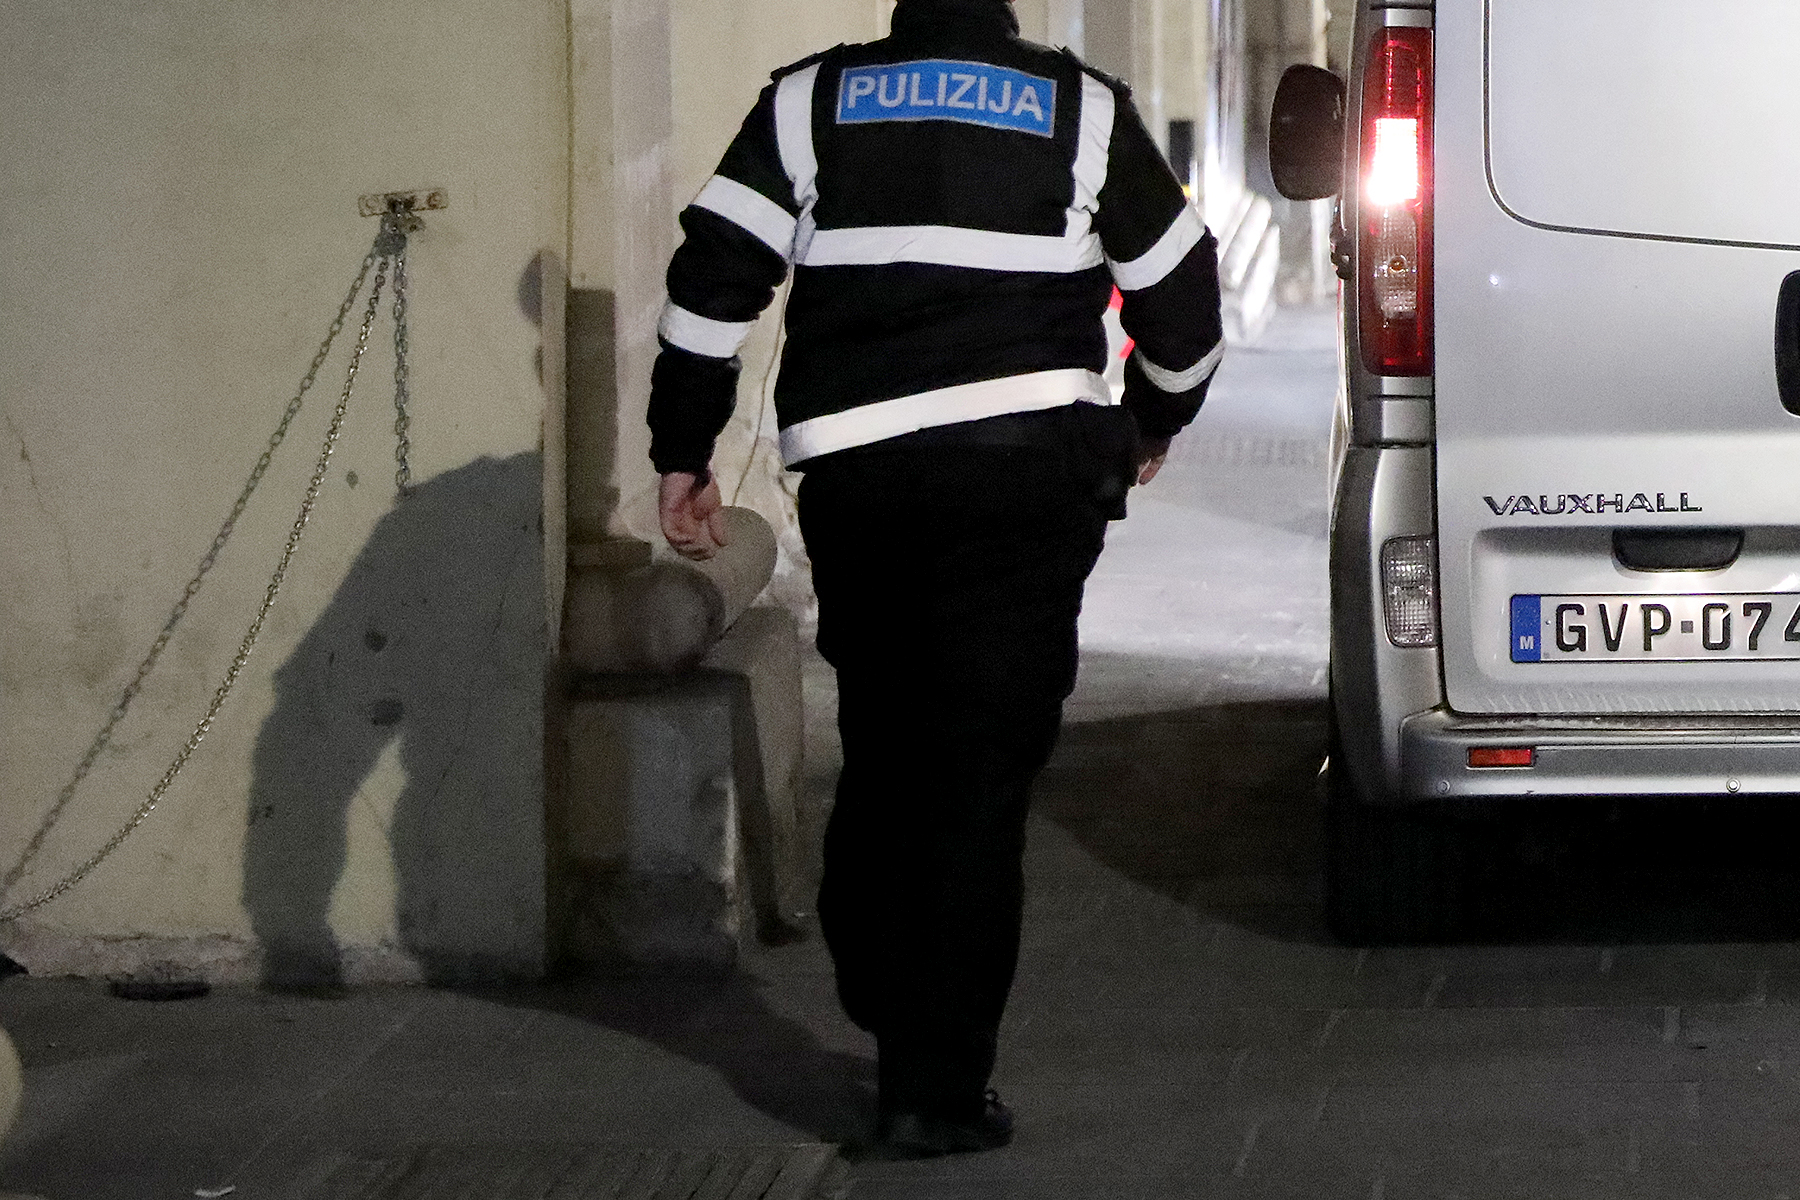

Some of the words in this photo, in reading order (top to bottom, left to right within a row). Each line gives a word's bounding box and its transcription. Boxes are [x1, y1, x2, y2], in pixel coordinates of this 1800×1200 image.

[847, 72, 1044, 122] PULIZIJA
[1482, 492, 1703, 516] VAUXHALL
[1519, 636, 1534, 650] M
